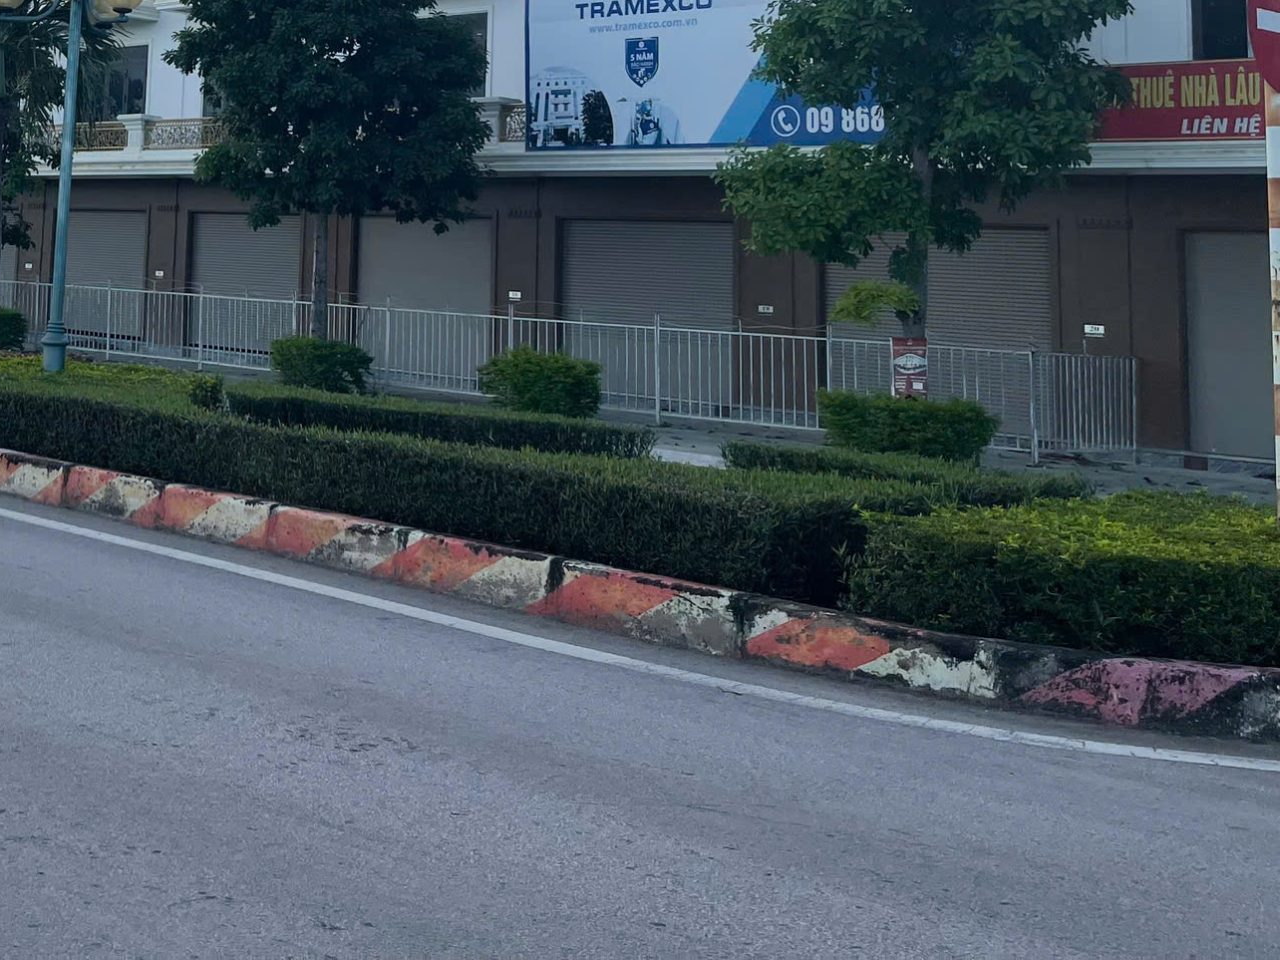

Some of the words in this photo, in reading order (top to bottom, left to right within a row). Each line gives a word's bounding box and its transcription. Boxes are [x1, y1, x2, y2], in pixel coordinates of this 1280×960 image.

[588, 17, 698, 33] www.tramexco.com.vn
[1180, 67, 1219, 107] NHÀ
[1225, 66, 1261, 106] LÂU
[806, 106, 834, 133] 09
[1181, 115, 1228, 135] LIÊN
[1233, 113, 1261, 136] HỆ
